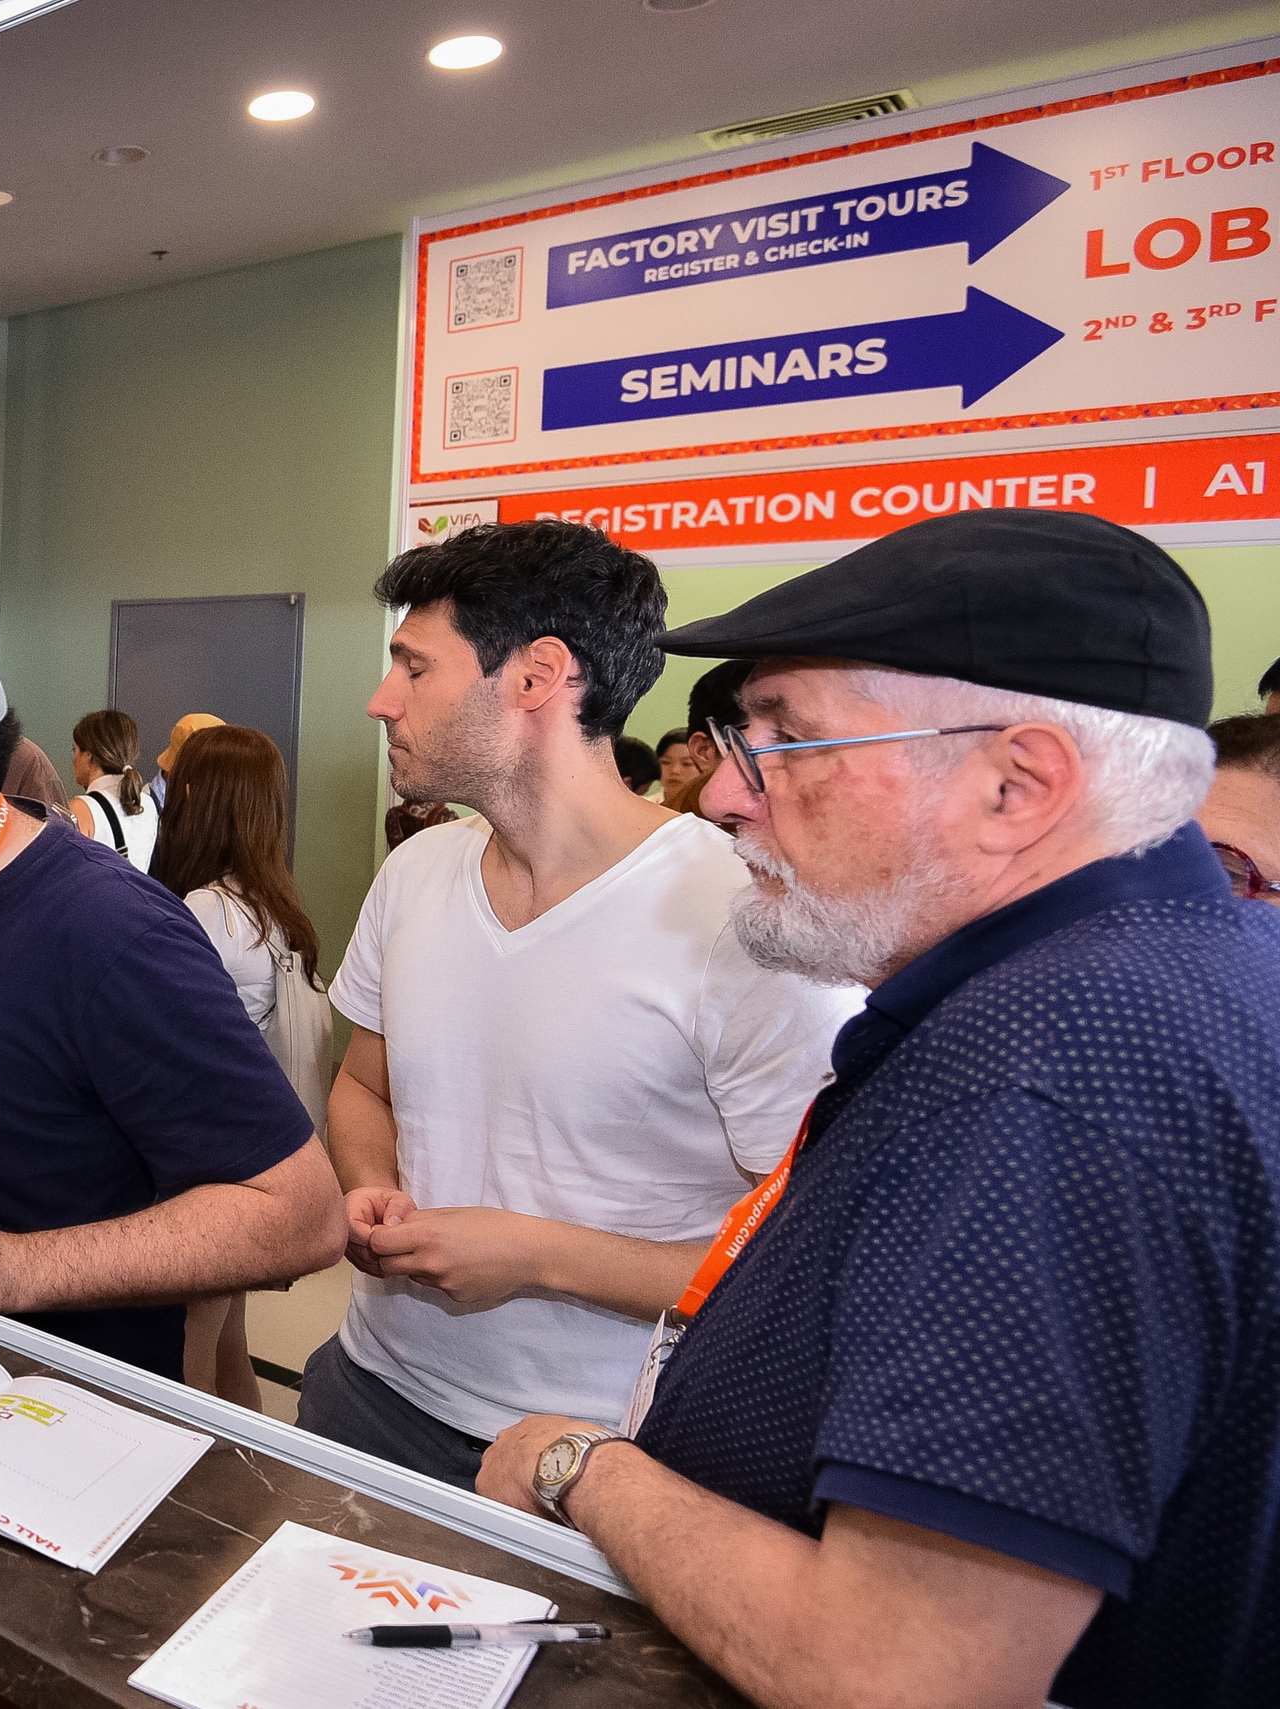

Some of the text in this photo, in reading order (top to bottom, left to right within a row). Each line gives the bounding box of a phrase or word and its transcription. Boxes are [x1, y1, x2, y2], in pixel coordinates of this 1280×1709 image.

[1141, 141, 1275, 183] FLOOR
[567, 180, 970, 274] FACTORY VISIT TOURS
[644, 230, 870, 283] REGISTER & CHECK-IN
[1084, 206, 1272, 279] LOB
[1082, 298, 1278, 342] 2ND & 3RD F
[621, 337, 888, 403] SEMINARS
[535, 491, 835, 534] GISTRATION
[850, 473, 1097, 517] COUNTER
[1203, 461, 1265, 498] A1
[16, 1522, 62, 1553] HALL
